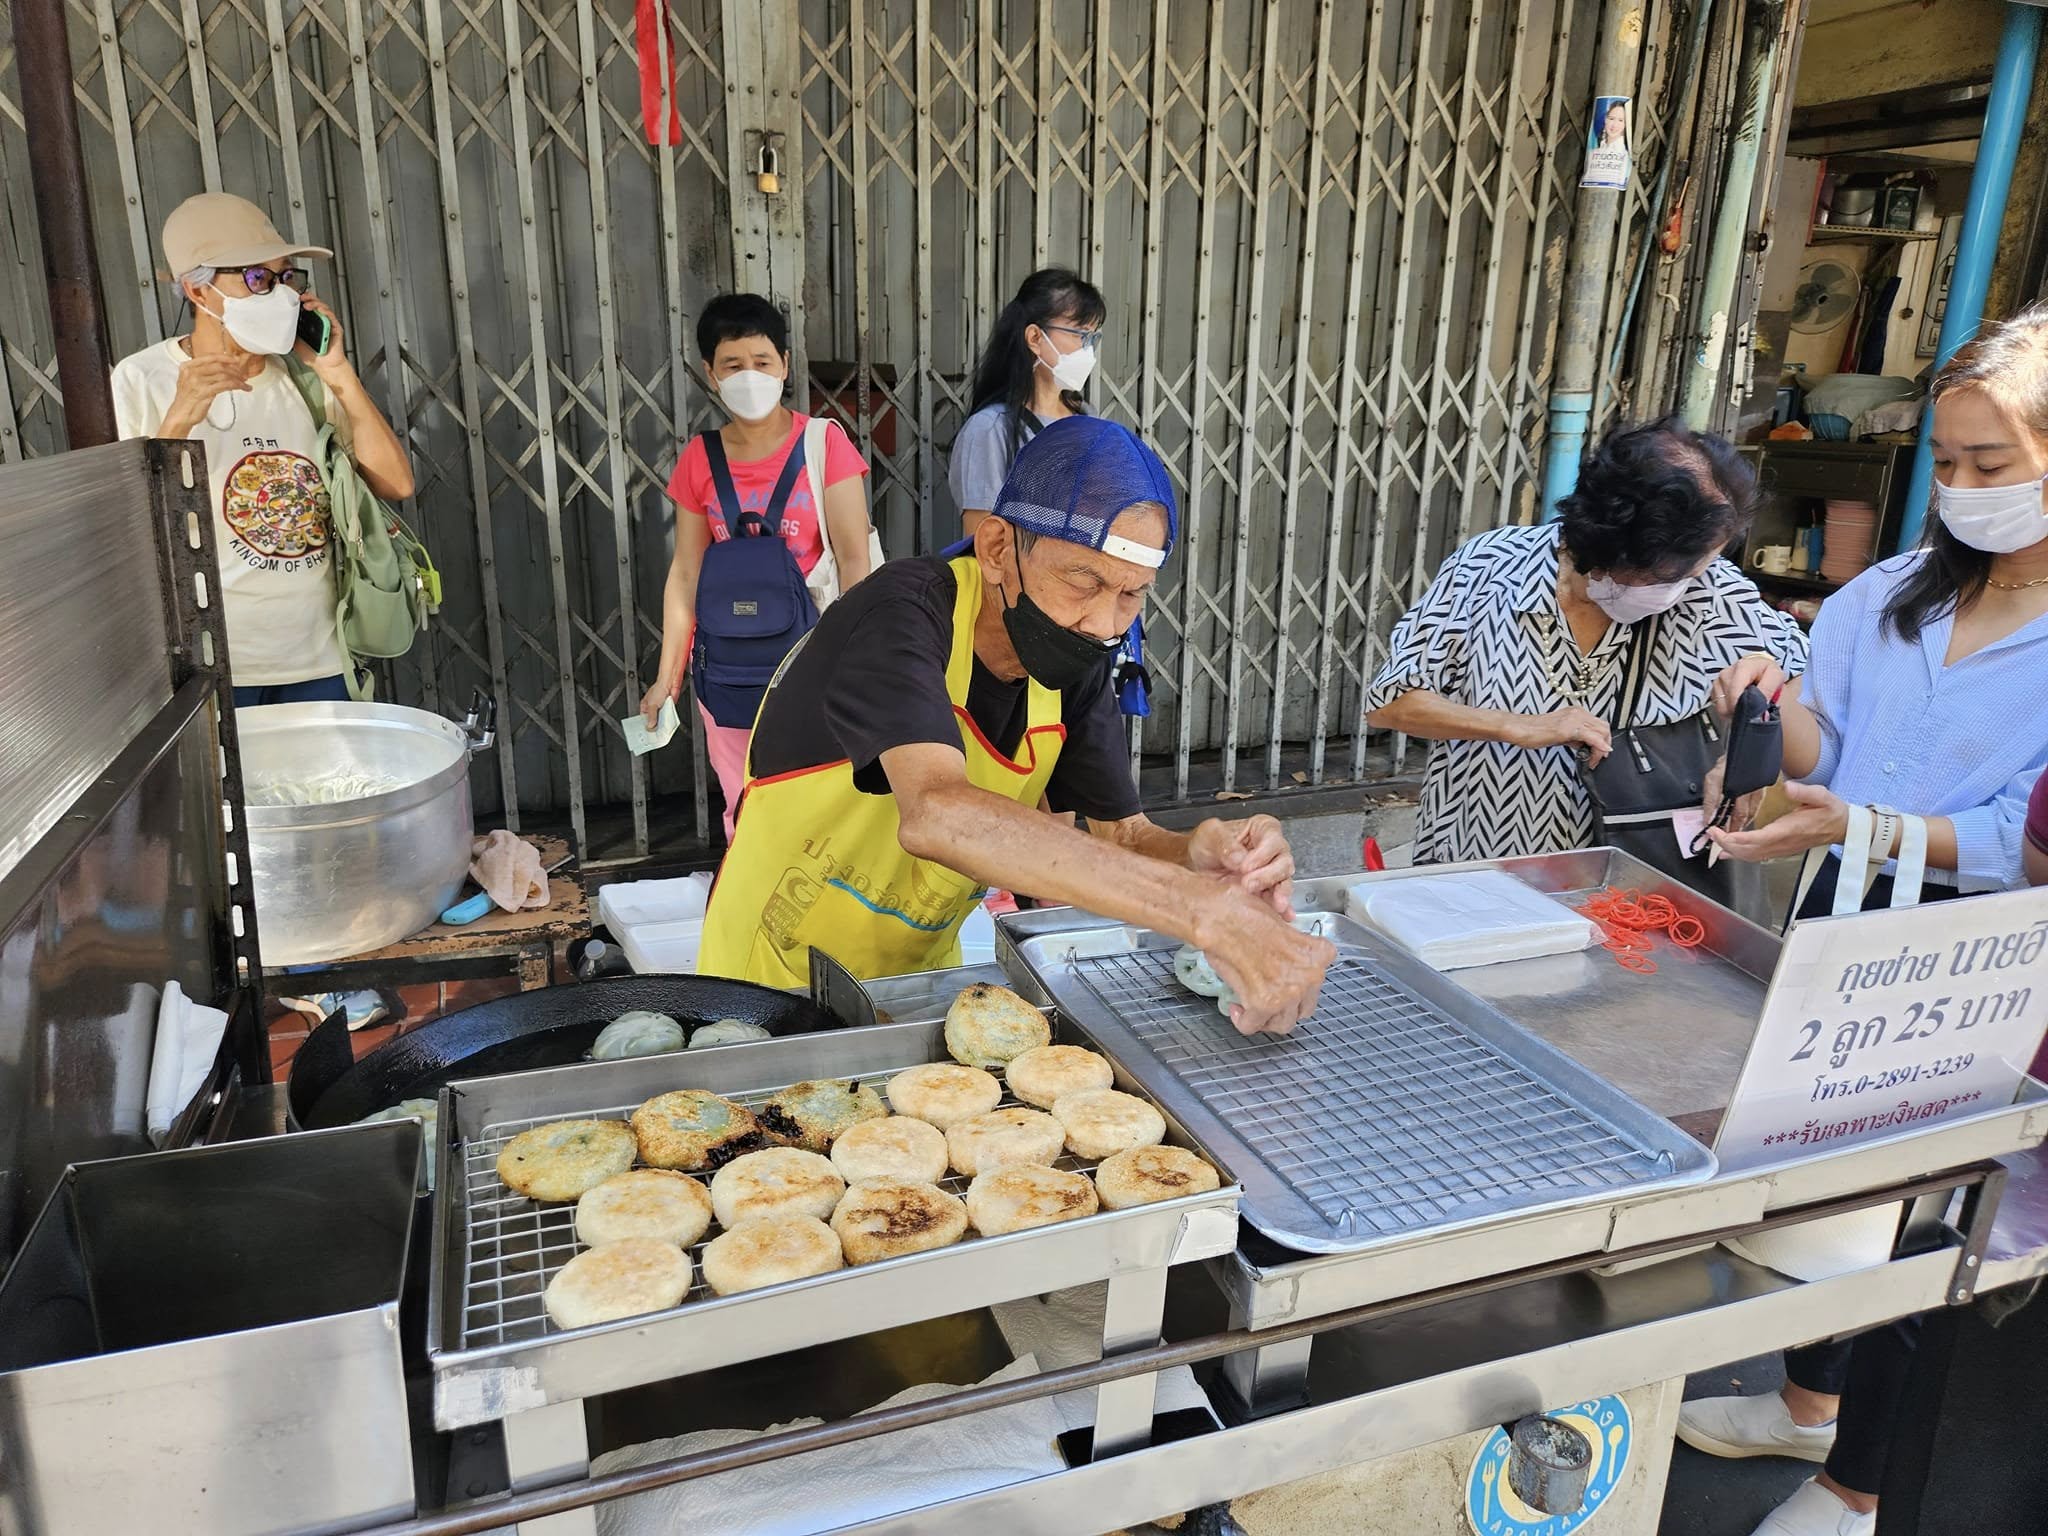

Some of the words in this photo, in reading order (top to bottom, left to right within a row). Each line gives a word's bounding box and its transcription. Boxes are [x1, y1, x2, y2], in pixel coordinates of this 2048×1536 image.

[284, 560, 301, 573] OF
[1836, 945, 1942, 1004] กุยช่าย
[1788, 1019, 1822, 1062] 2
[1829, 1016, 1887, 1069] ลูก
[1892, 996, 1953, 1043] 25
[1954, 987, 2031, 1031] บาท
[1810, 1052, 1975, 1102] โทร.0-2891-3239
